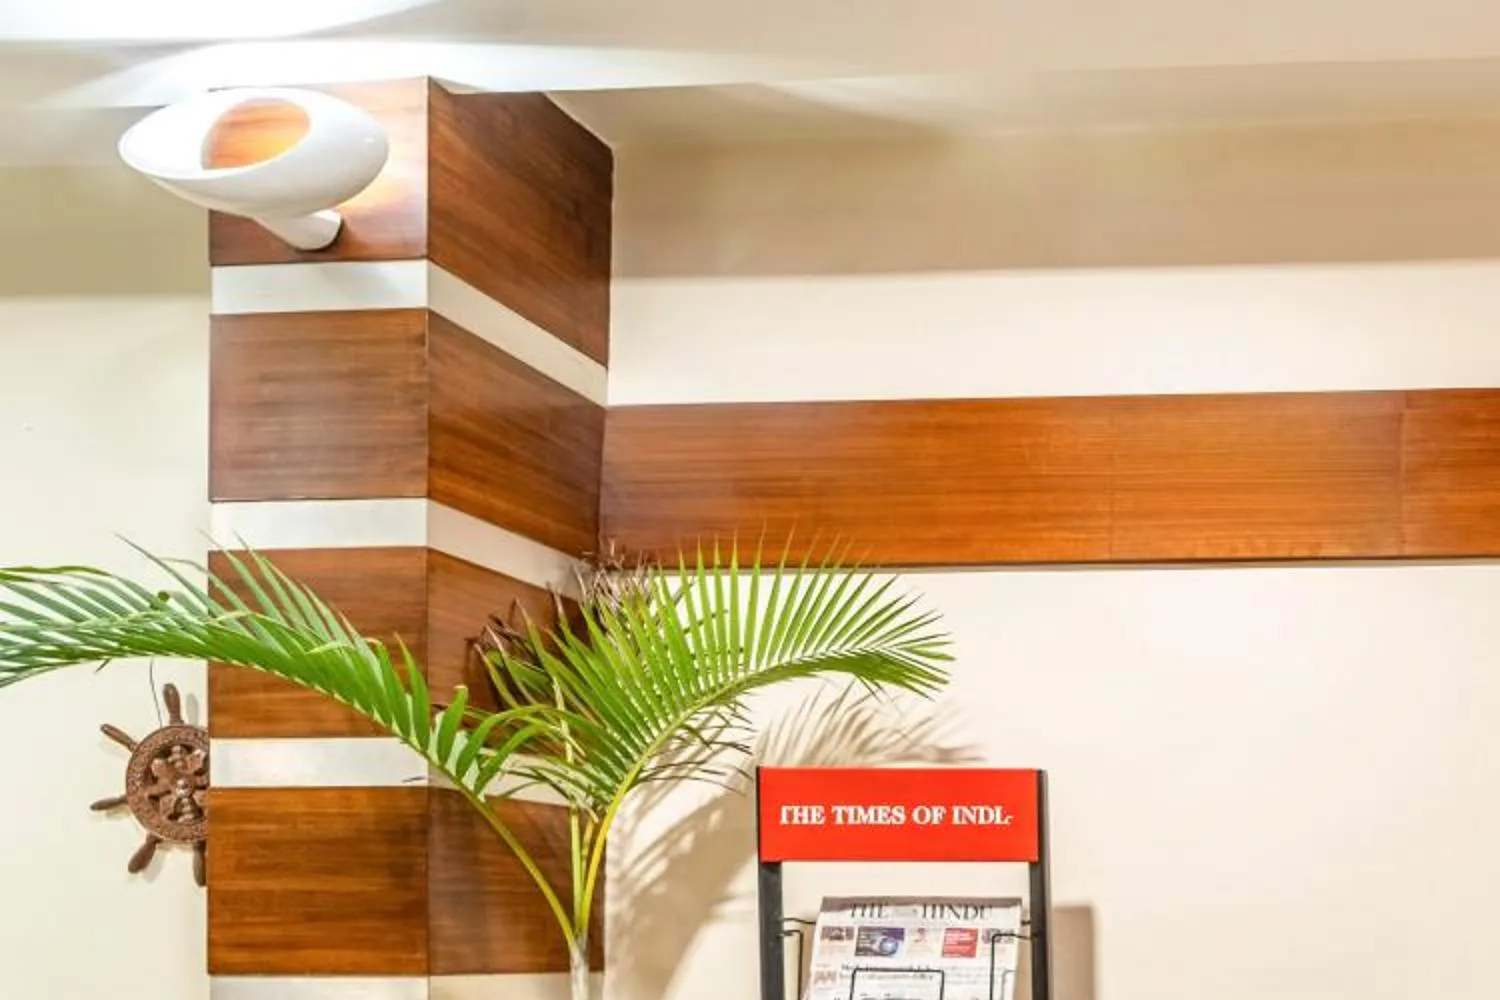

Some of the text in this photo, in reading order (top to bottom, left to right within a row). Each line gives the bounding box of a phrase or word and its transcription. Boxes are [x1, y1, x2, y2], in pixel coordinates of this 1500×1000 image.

[831, 805, 906, 825] TIMES
[912, 805, 946, 825] OF
[952, 805, 1013, 825] INDI
